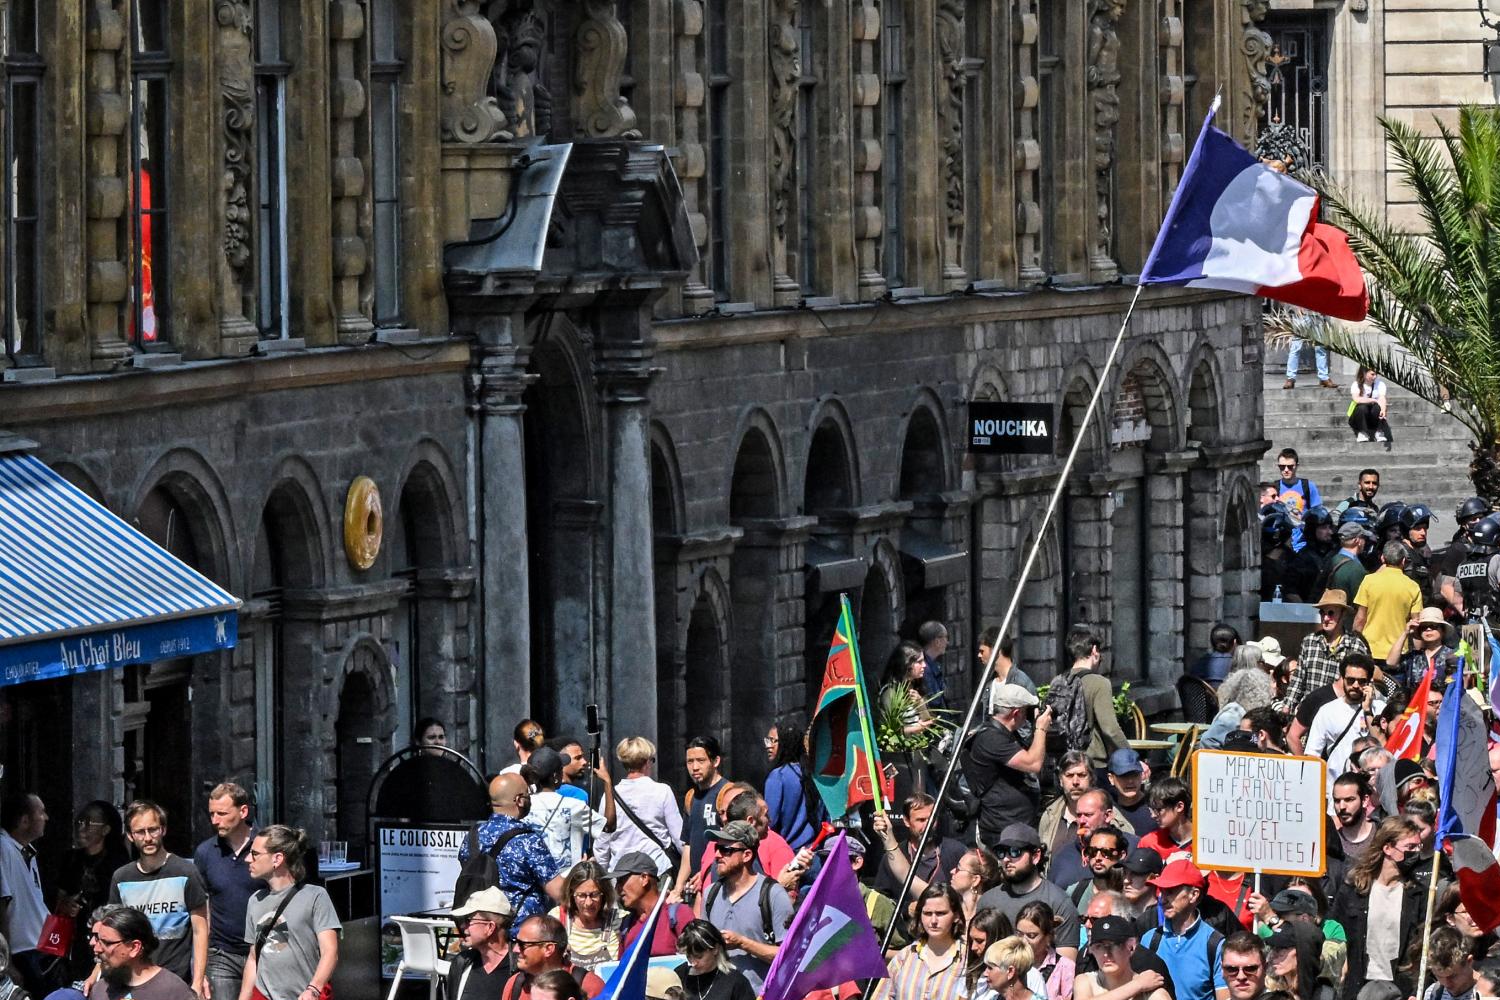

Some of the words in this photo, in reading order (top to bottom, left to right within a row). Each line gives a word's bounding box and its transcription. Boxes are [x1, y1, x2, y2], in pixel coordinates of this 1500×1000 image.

[974, 419, 1048, 437] NOUCHKA
[1459, 564, 1487, 577] POLICE
[60, 639, 78, 670] Au
[80, 637, 111, 666] Chat
[113, 633, 141, 661] Bleu
[1226, 756, 1285, 780] MACRON
[1300, 761, 1304, 784] !
[1209, 778, 1223, 793] LA
[1232, 777, 1291, 801] FRANCE
[1204, 797, 1218, 812] TU
[1225, 796, 1303, 822] L'ÉCOUTES
[382, 829, 395, 846] LE
[1200, 838, 1215, 853] TU
[1223, 839, 1237, 854] LA
[1244, 839, 1304, 863] QUITTES
